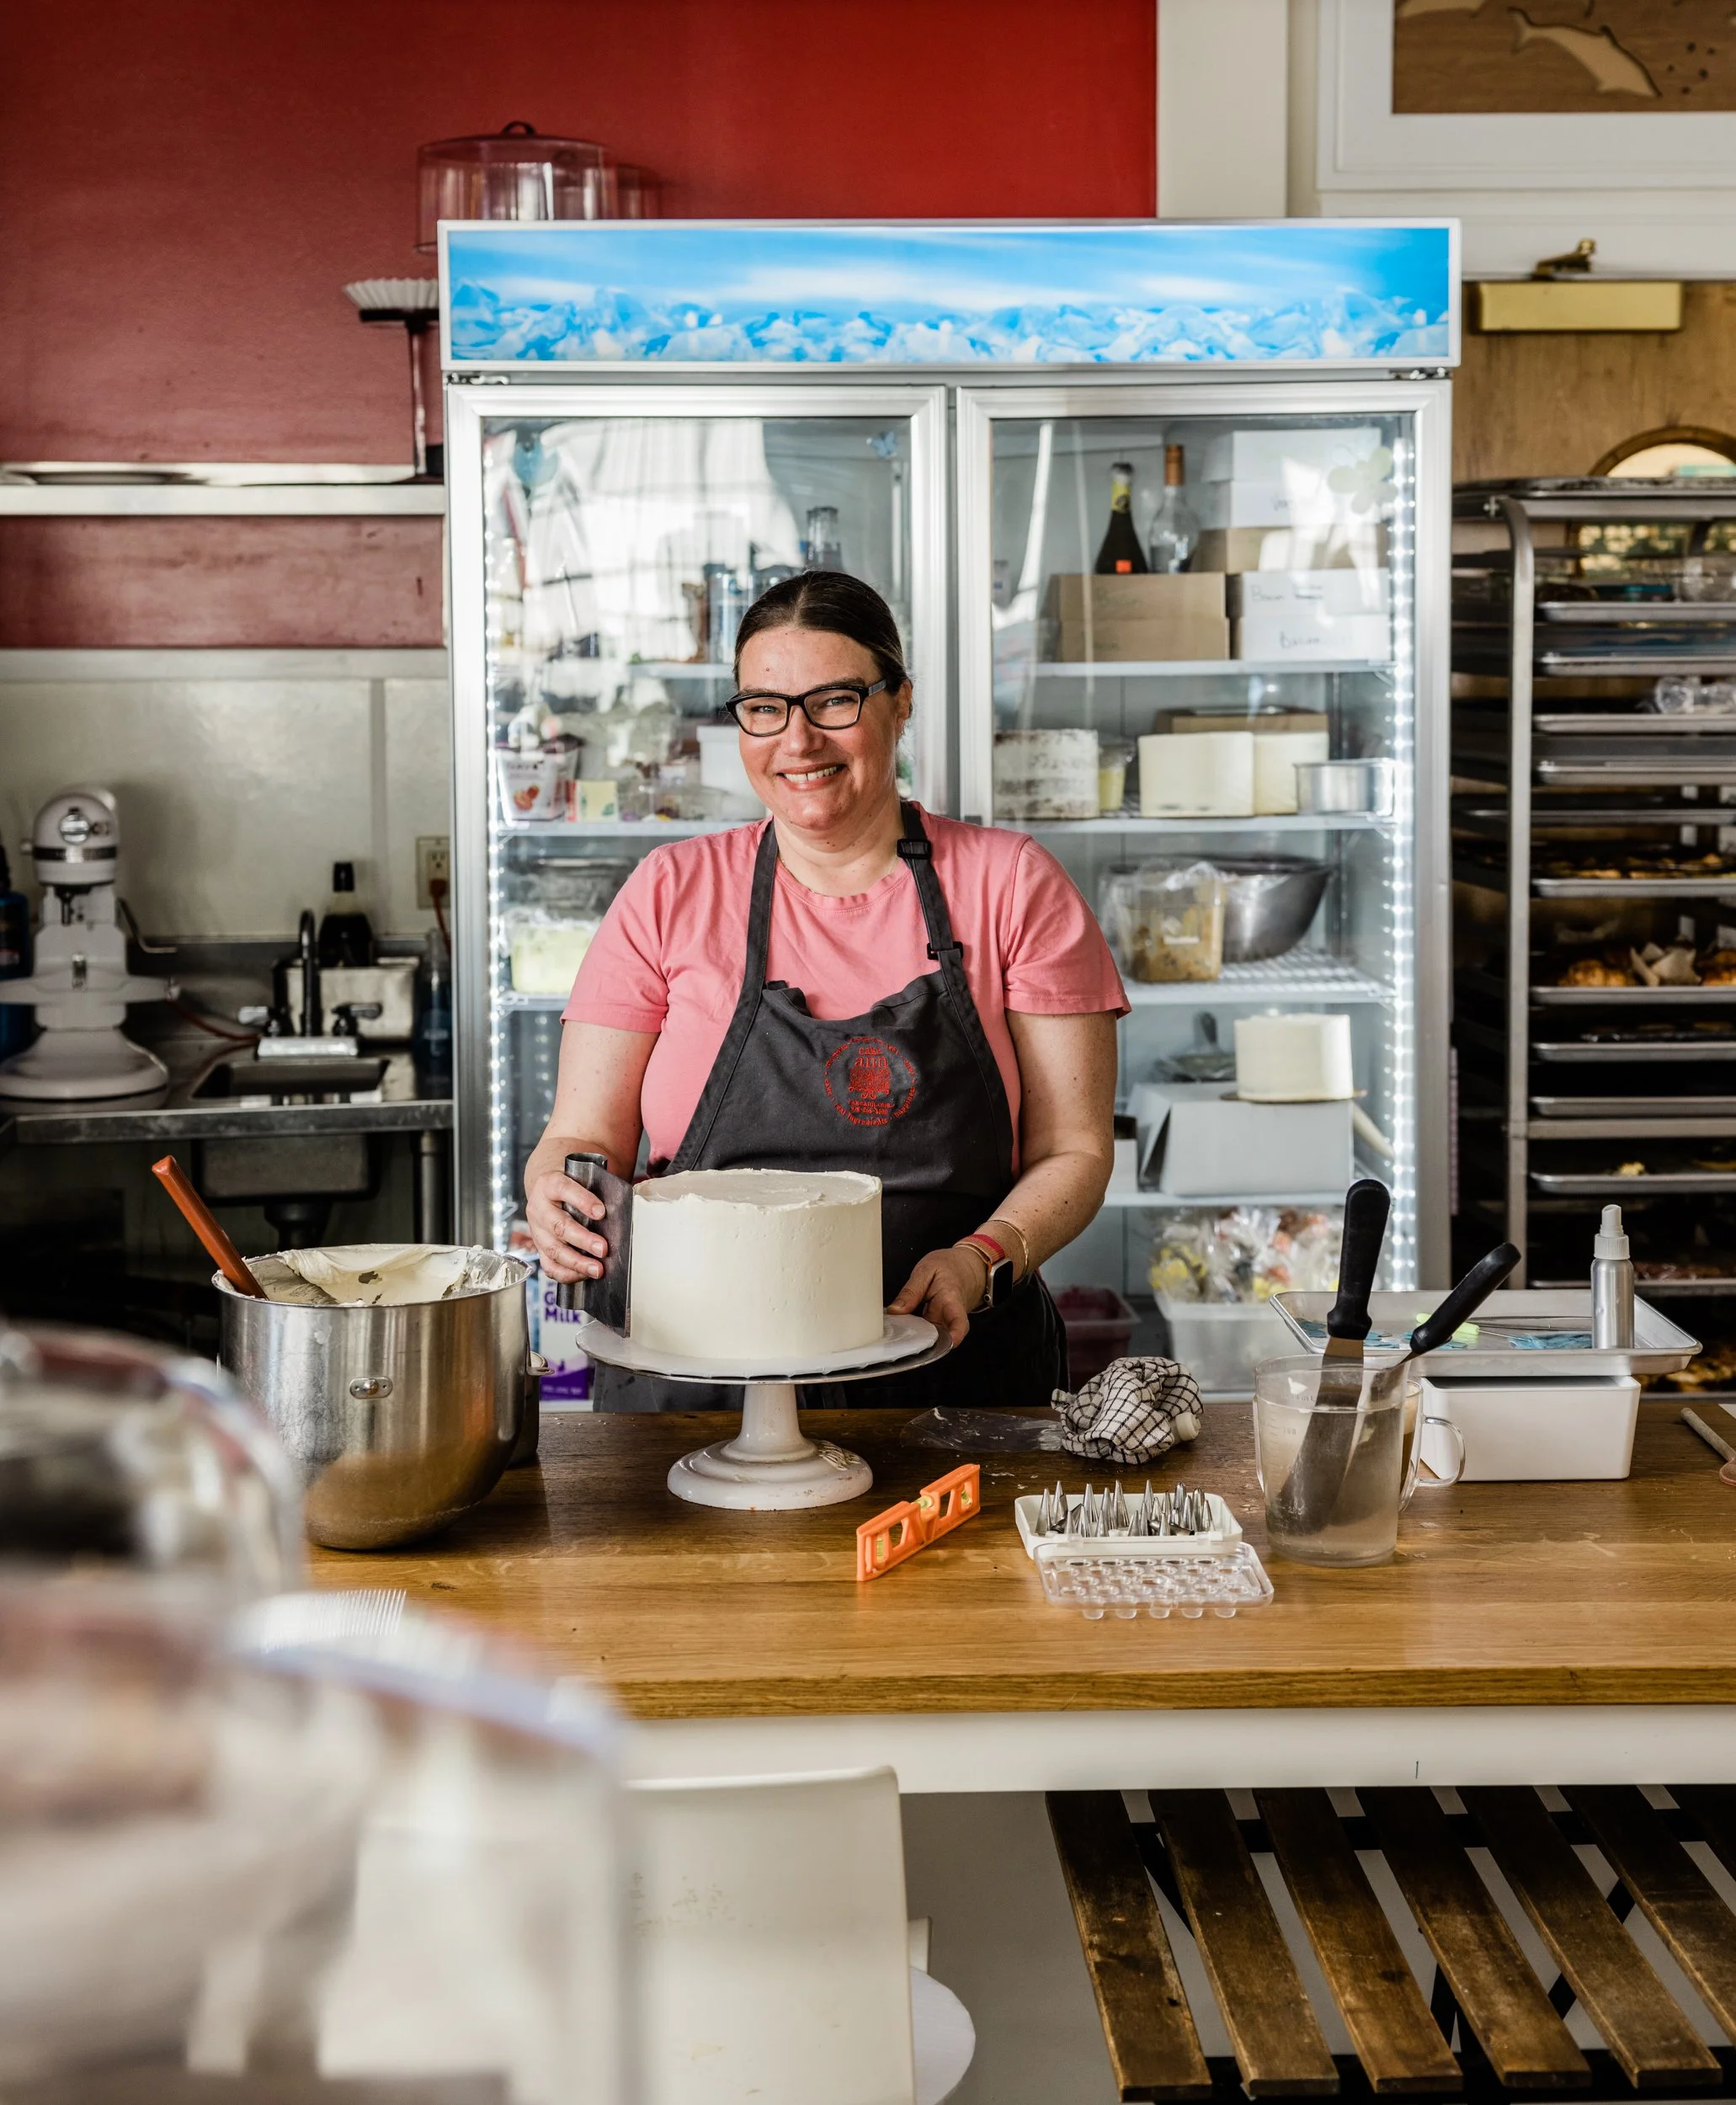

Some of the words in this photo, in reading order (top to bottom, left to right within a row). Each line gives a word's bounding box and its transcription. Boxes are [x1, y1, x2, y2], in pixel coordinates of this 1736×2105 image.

[859, 1045, 881, 1054] cake
[855, 1057, 888, 1067] ann
[545, 1307, 581, 1323] Milk
